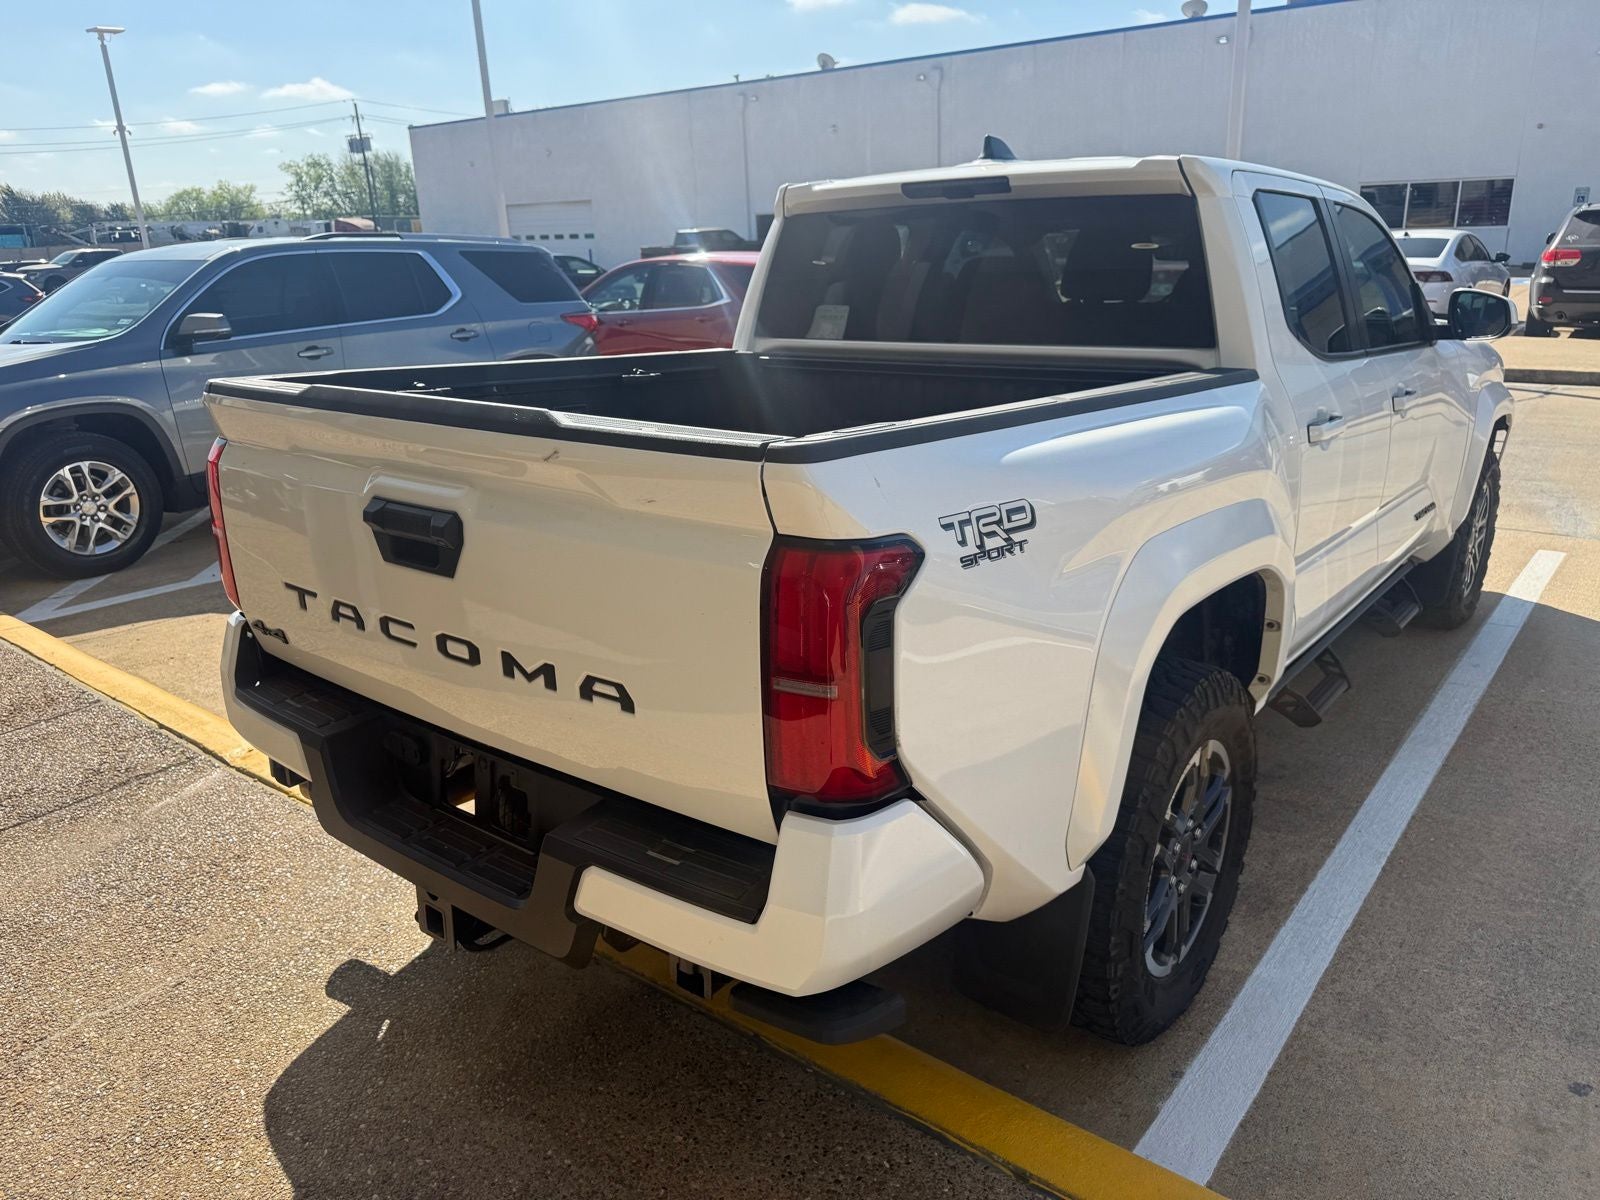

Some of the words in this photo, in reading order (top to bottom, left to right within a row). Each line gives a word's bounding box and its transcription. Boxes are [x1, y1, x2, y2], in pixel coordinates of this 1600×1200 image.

[938, 498, 1037, 551] TRD
[959, 539, 1029, 570] SPORT
[283, 581, 636, 715] TACOMA
